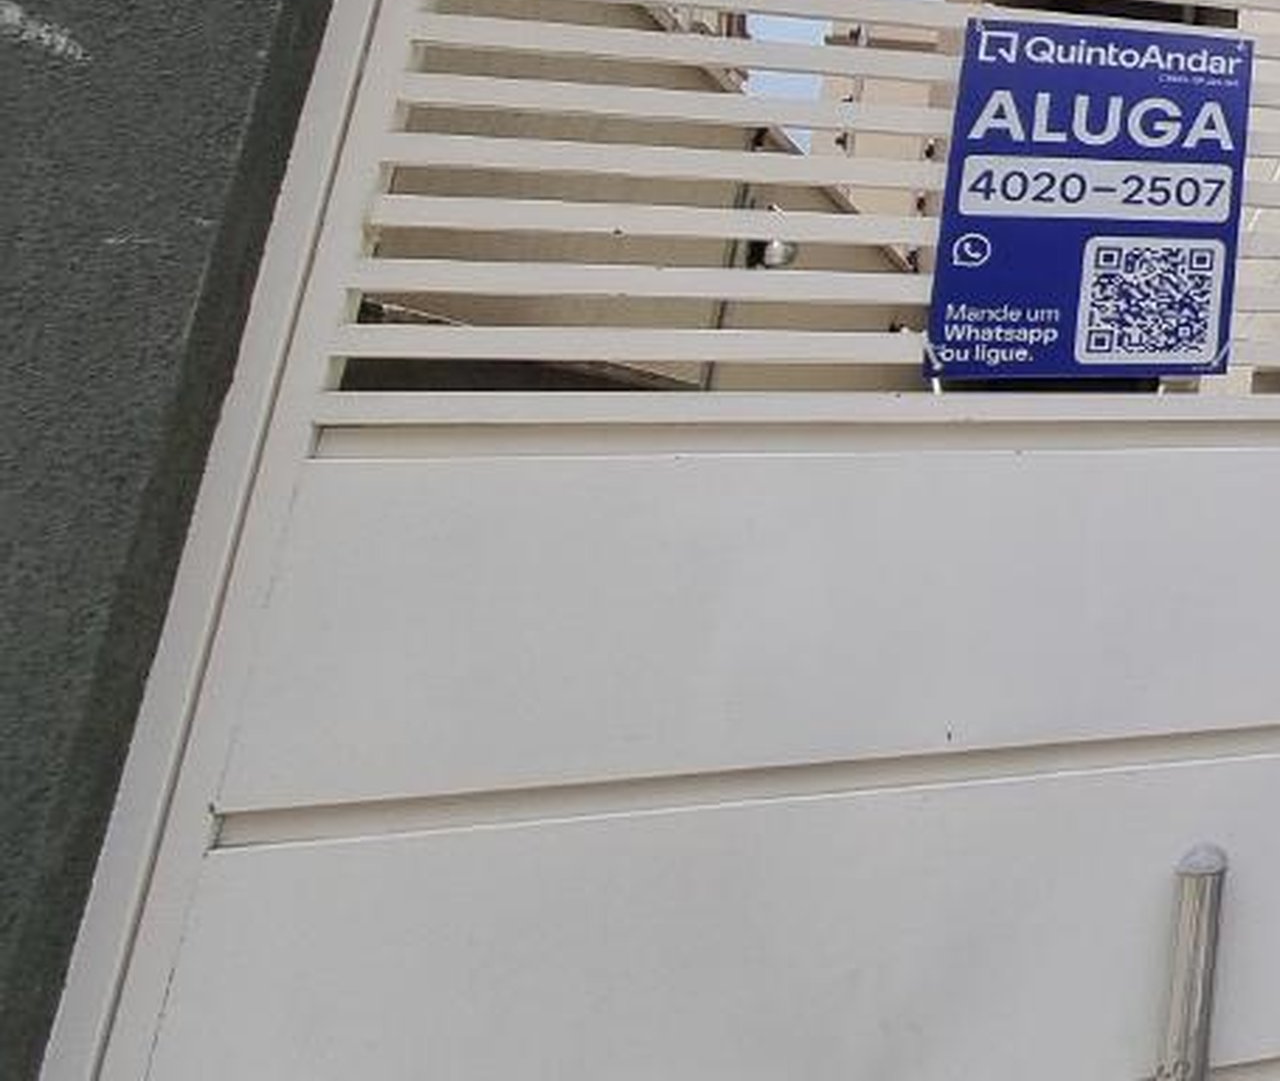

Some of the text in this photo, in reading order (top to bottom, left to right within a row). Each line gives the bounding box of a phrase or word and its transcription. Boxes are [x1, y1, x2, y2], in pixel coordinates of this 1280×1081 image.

[1024, 35, 1243, 75] QuintoAndar
[967, 89, 1235, 150] ALUGA
[968, 169, 1227, 207] 4020-2507
[945, 303, 1060, 322] Mande um
[944, 324, 1059, 345] Whatsapp
[975, 344, 1034, 366] ligue.
